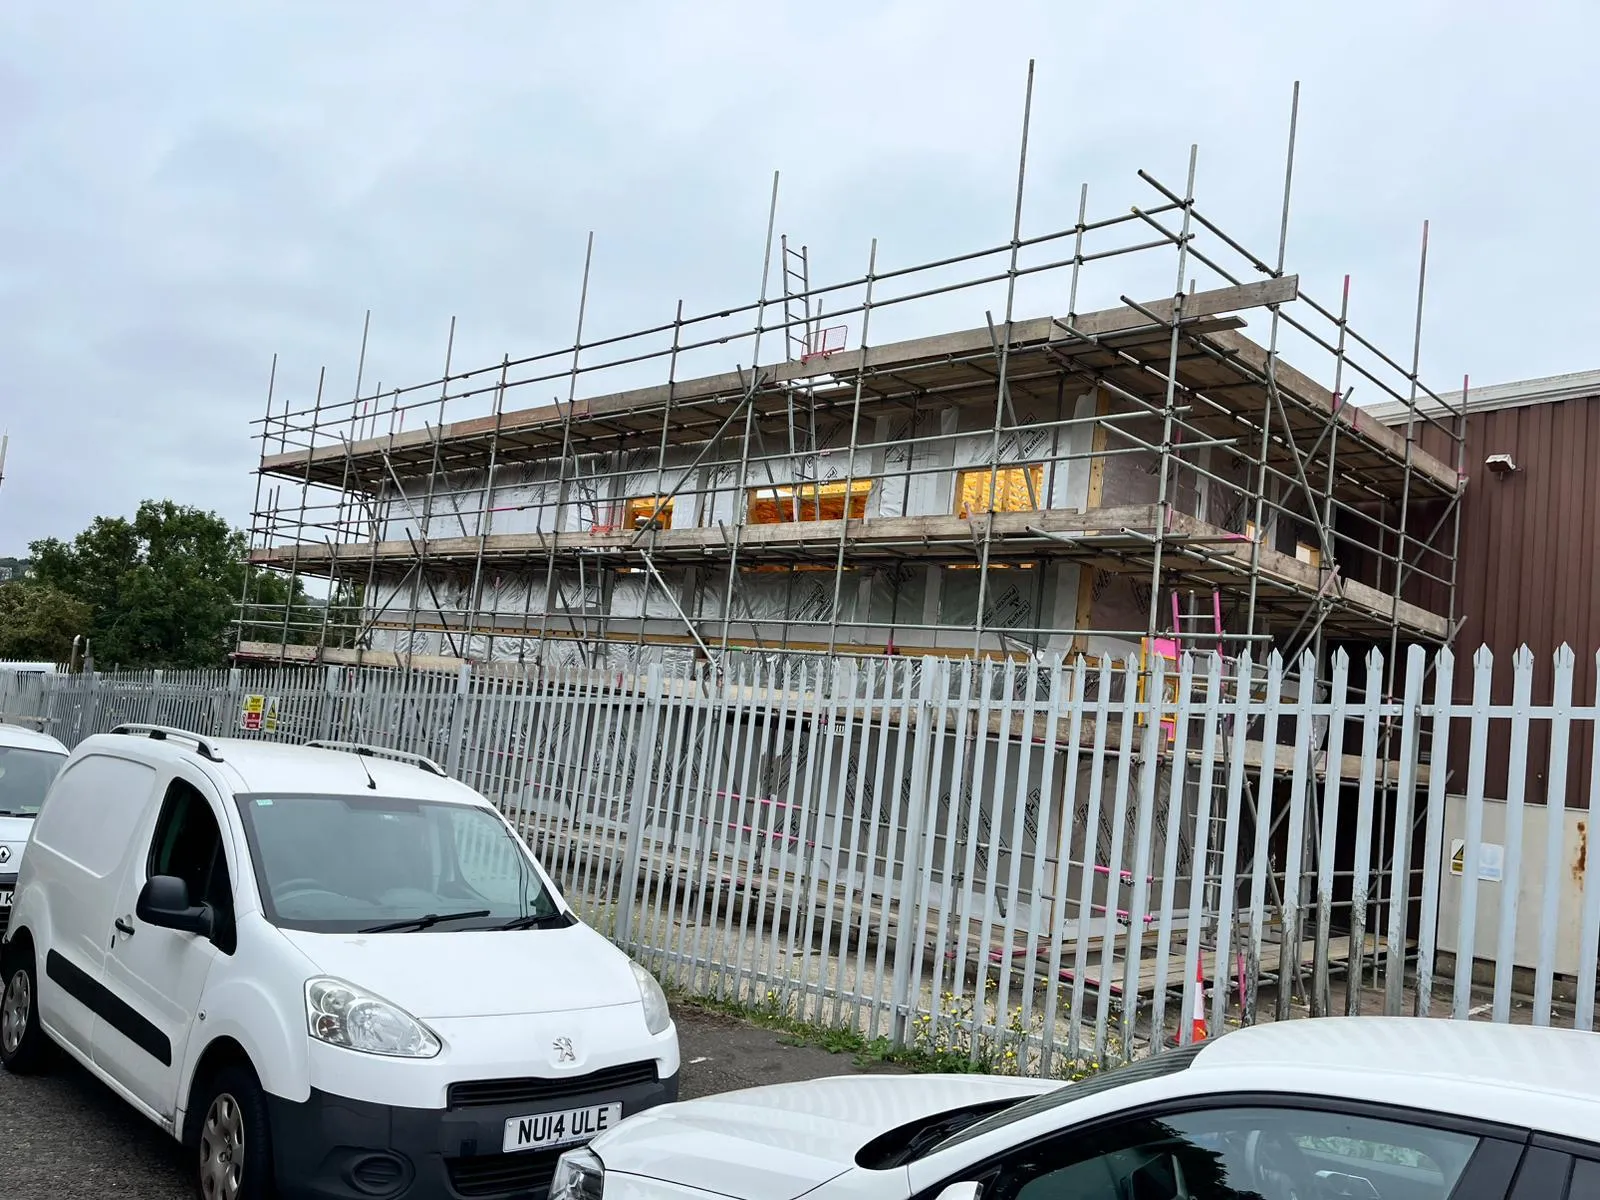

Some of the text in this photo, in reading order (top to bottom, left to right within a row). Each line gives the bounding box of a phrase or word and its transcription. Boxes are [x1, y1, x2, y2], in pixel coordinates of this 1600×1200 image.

[1023, 430, 1045, 454] Reflect
[517, 1114, 566, 1145] NU14
[571, 1107, 609, 1135] ULE
